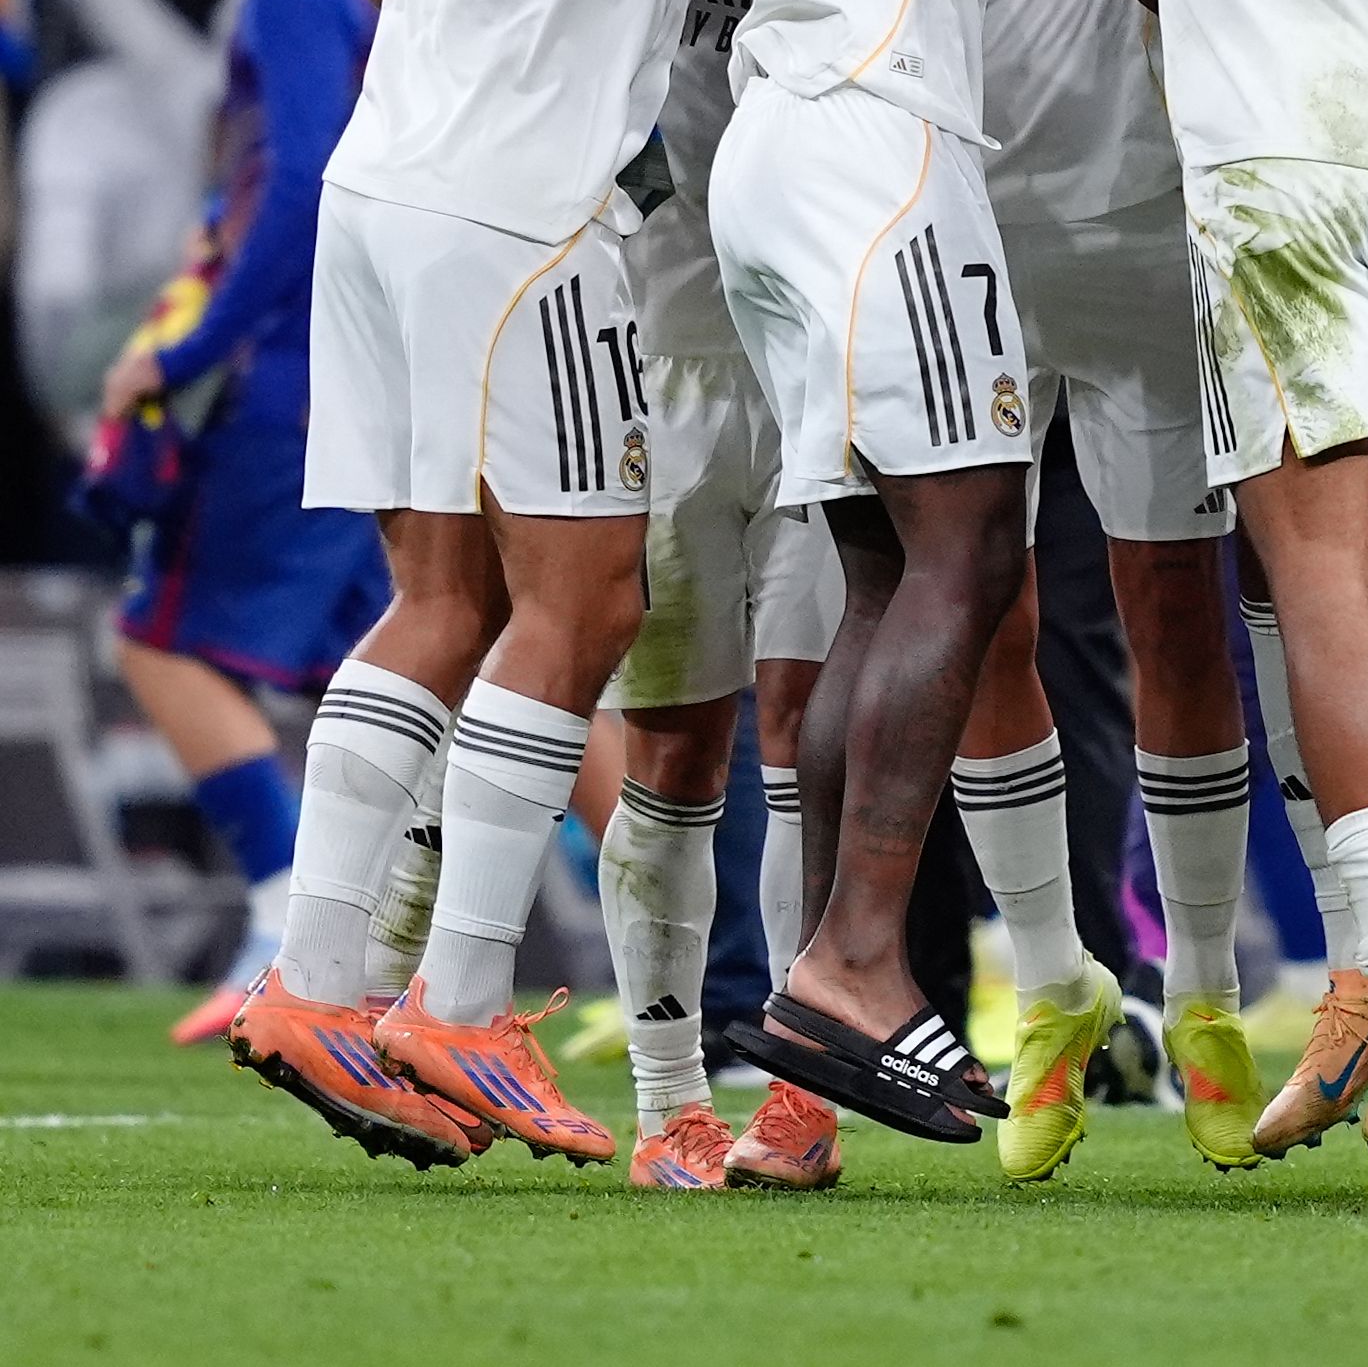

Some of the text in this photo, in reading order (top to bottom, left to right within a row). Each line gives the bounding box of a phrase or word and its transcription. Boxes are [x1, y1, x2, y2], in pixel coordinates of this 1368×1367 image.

[961, 263, 1004, 356] 7
[881, 1054, 940, 1087] adidas
[532, 1118, 609, 1139] F50
